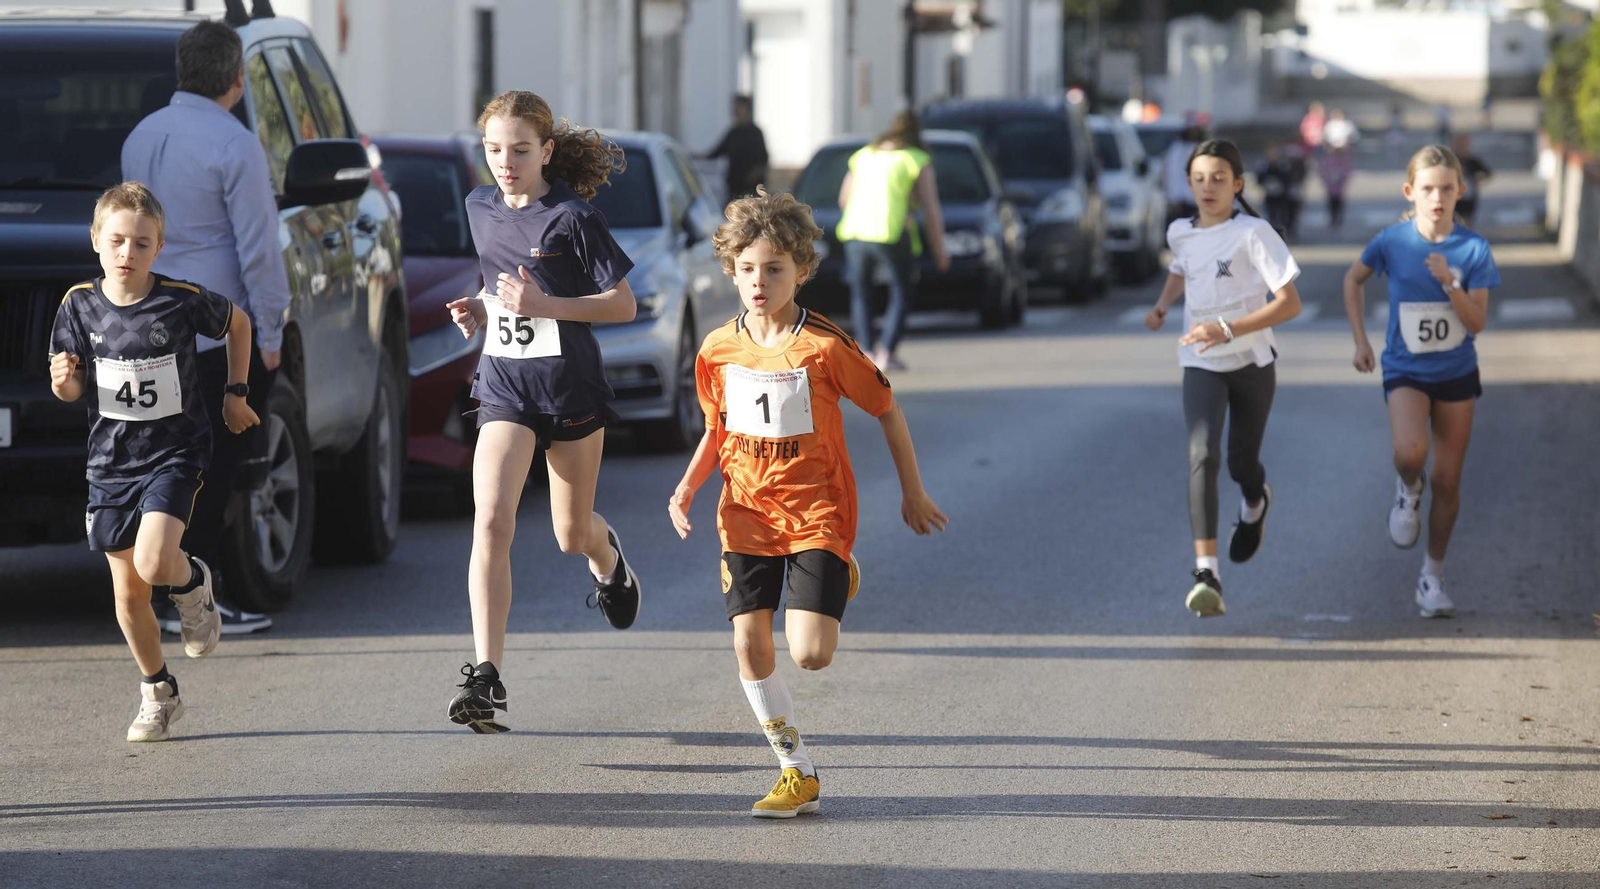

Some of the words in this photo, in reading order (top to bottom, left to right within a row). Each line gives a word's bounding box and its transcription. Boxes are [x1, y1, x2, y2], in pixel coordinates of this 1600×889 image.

[498, 316, 535, 346] 55
[1418, 318, 1450, 342] 50
[143, 361, 172, 372] FRONTERA
[770, 375, 803, 384] FRONTERA
[115, 379, 158, 408] 45
[755, 392, 771, 424] 1
[753, 440, 799, 459] BETTER
